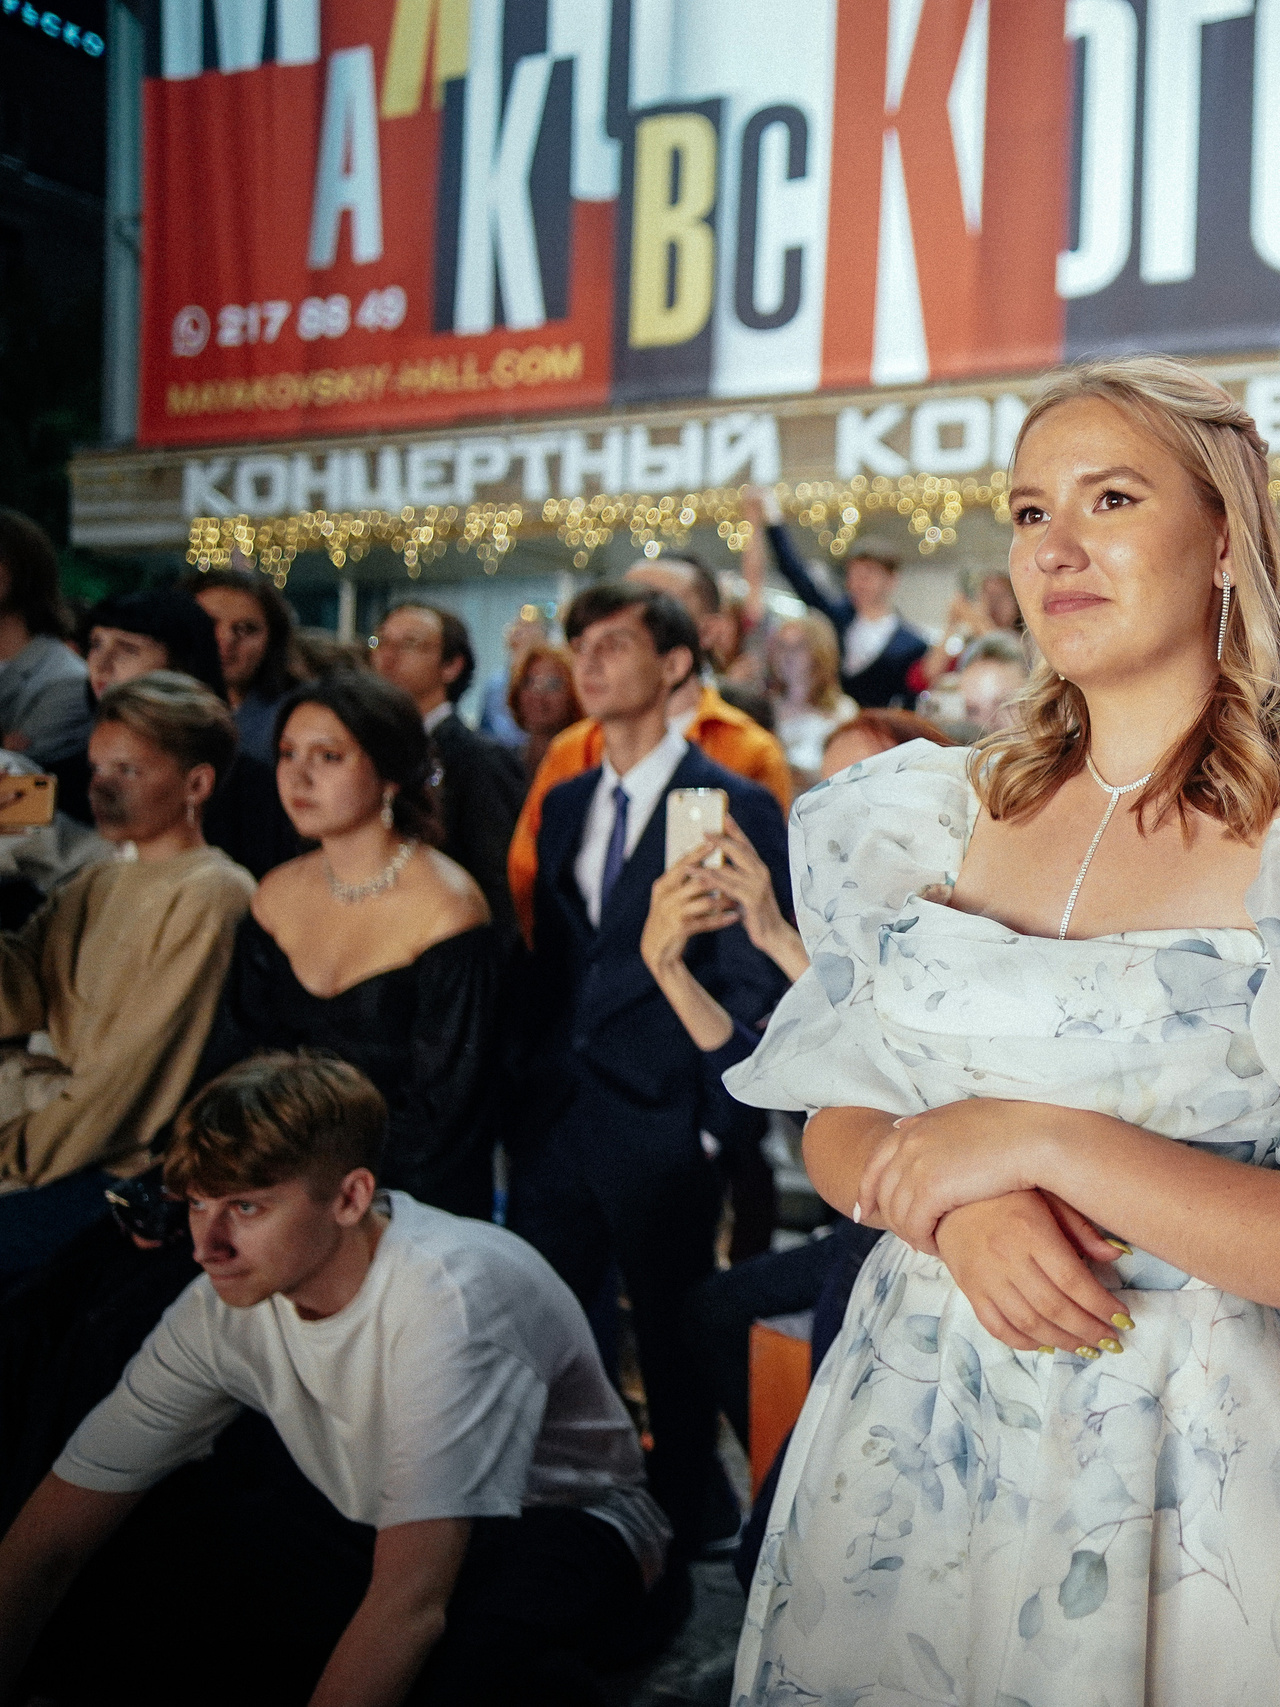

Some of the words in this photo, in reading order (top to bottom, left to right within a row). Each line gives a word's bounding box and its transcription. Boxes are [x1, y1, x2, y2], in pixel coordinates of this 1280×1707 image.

[216, 302, 292, 348] 217
[354, 284, 408, 333] 49
[182, 412, 781, 517] КОНЦЕРТНЫЙ
